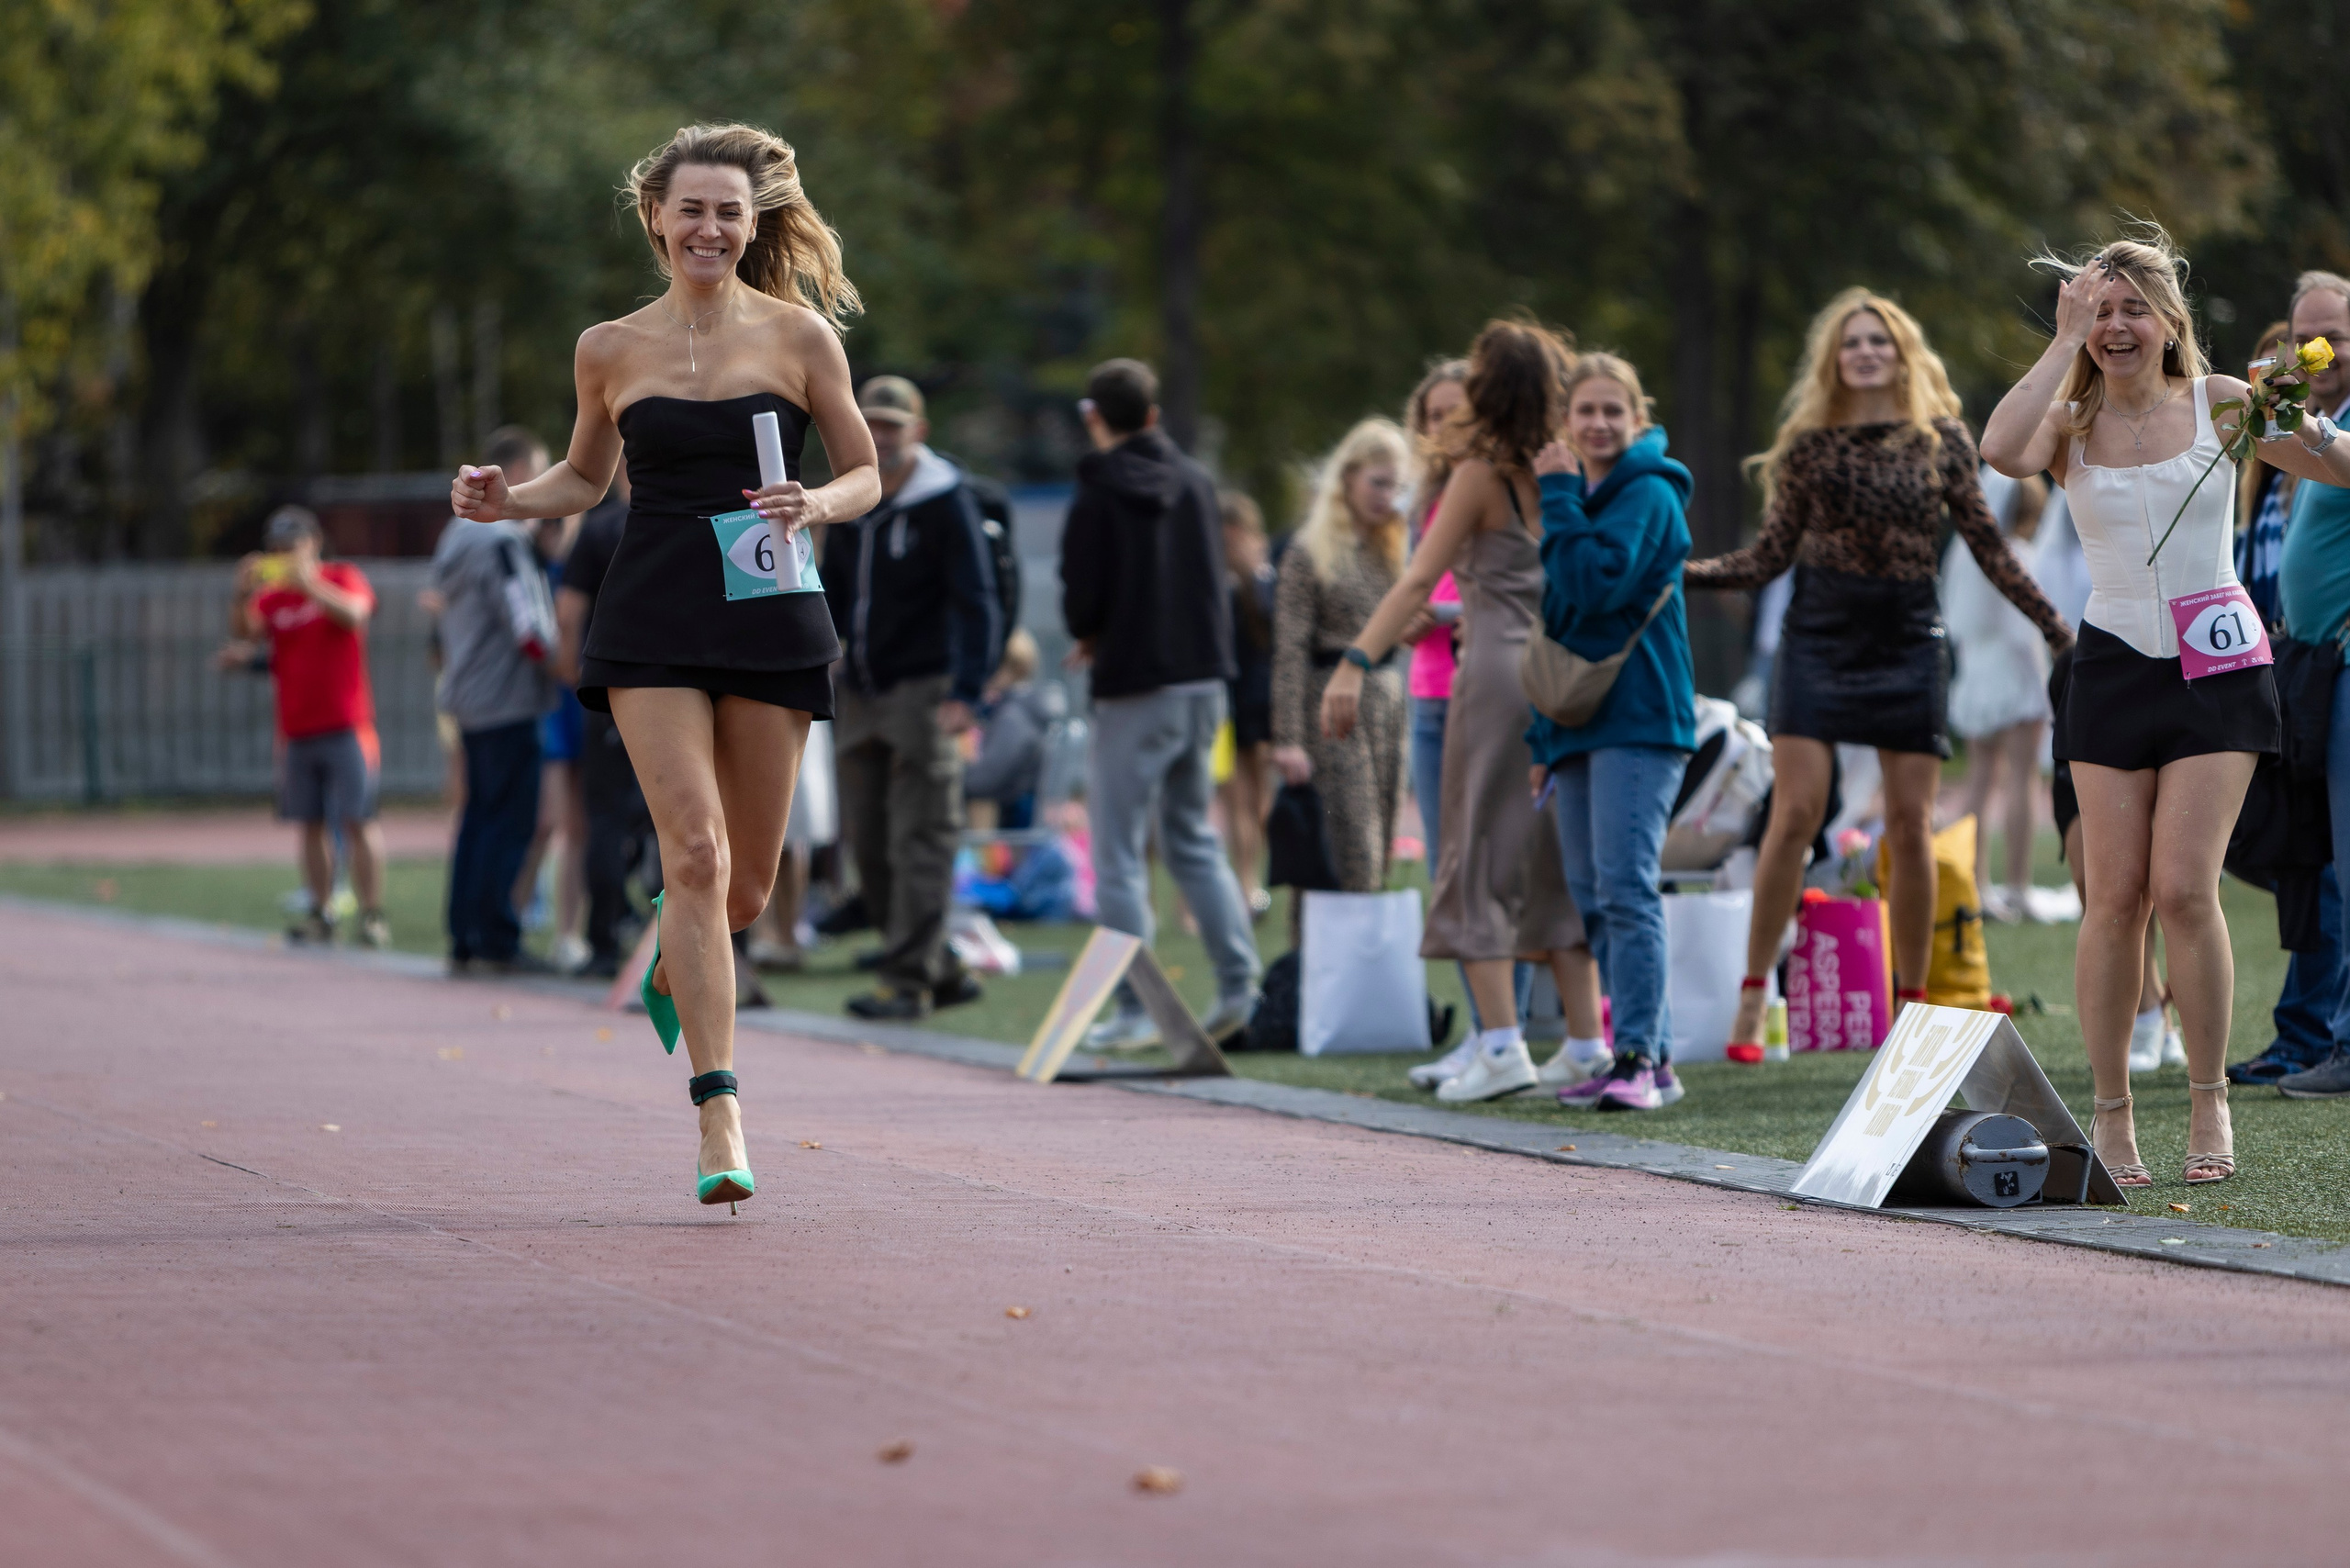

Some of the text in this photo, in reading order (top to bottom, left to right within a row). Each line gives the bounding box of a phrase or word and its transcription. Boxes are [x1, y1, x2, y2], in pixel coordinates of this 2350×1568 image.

[722, 513, 755, 524] ЖЕНСКИЙ
[762, 586, 778, 594] EVEN
[2180, 594, 2210, 607] ЖЕНСКИЙ
[2210, 591, 2224, 600] ЗАБЕГ
[2210, 610, 2250, 650] 61
[2217, 661, 2236, 671] EVENT
[1811, 929, 1842, 1052] ASPERA
[1844, 990, 1873, 1051] PER
